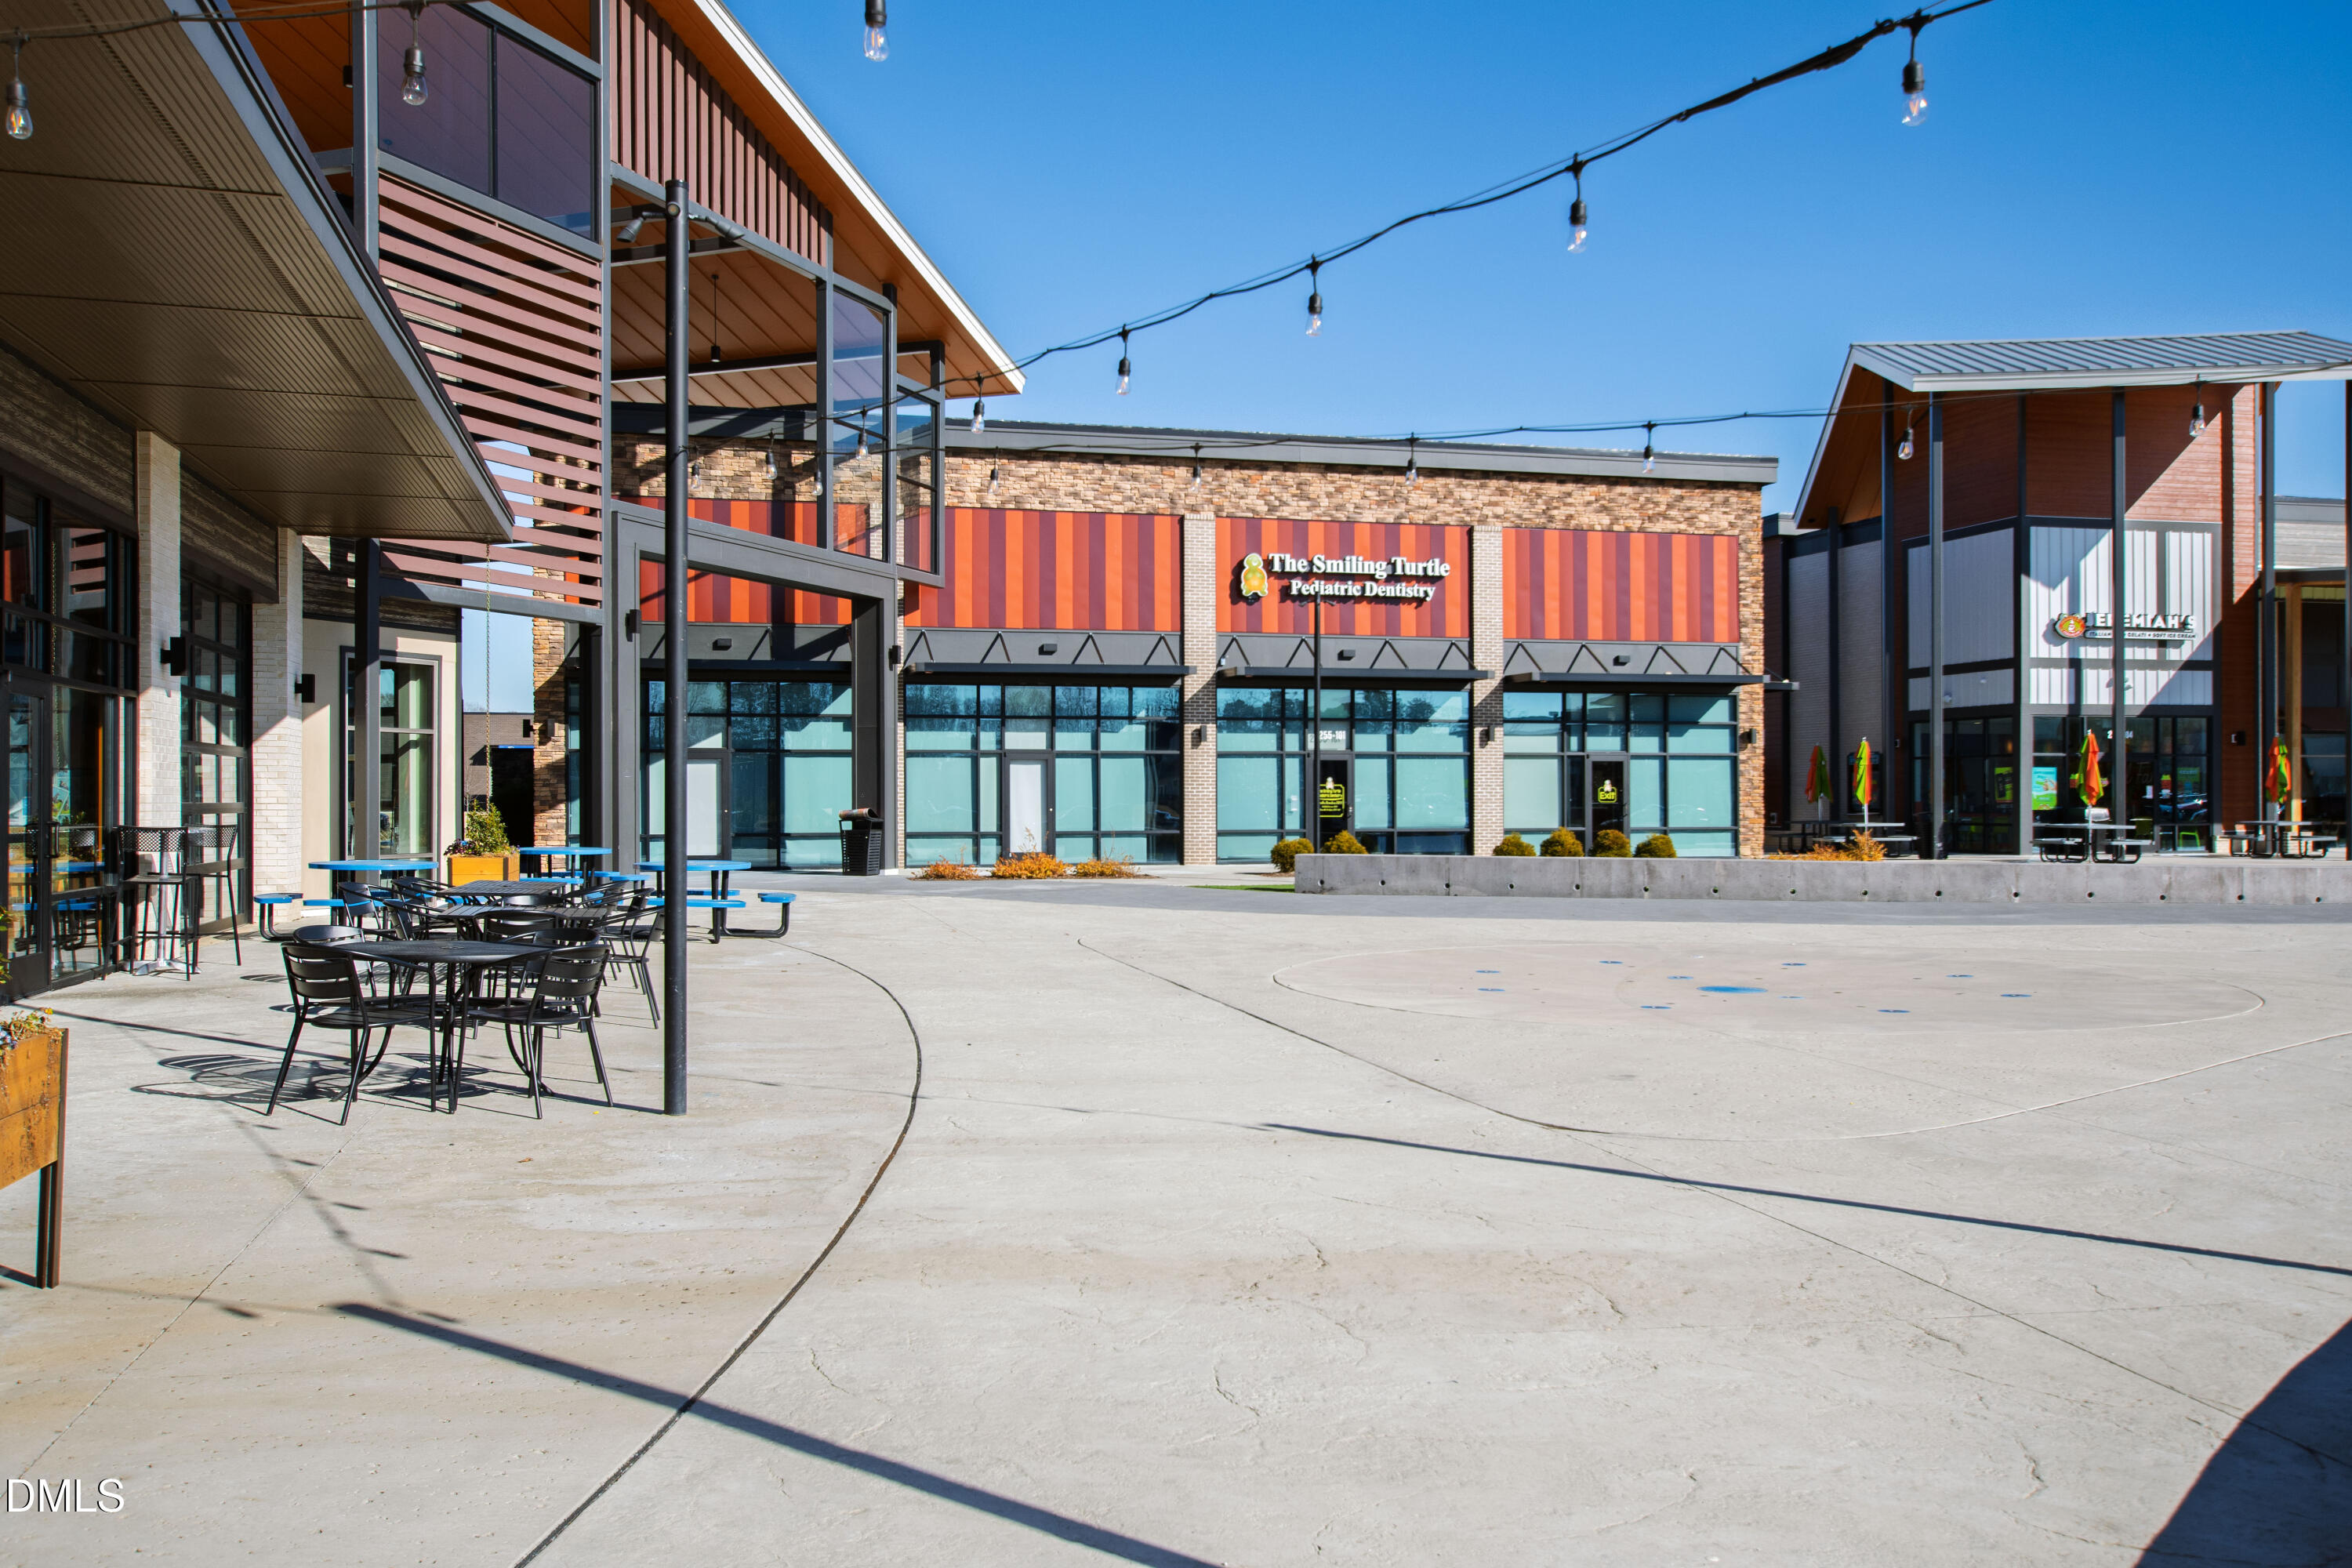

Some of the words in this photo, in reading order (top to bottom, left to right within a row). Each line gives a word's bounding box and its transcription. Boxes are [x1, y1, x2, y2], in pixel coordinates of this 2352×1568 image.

[1268, 553, 1308, 572] The
[1312, 554, 1388, 579] Smiling
[1391, 557, 1451, 577] Turtle
[1290, 580, 1363, 597] Pediatric
[1364, 582, 1436, 601] Dentistry
